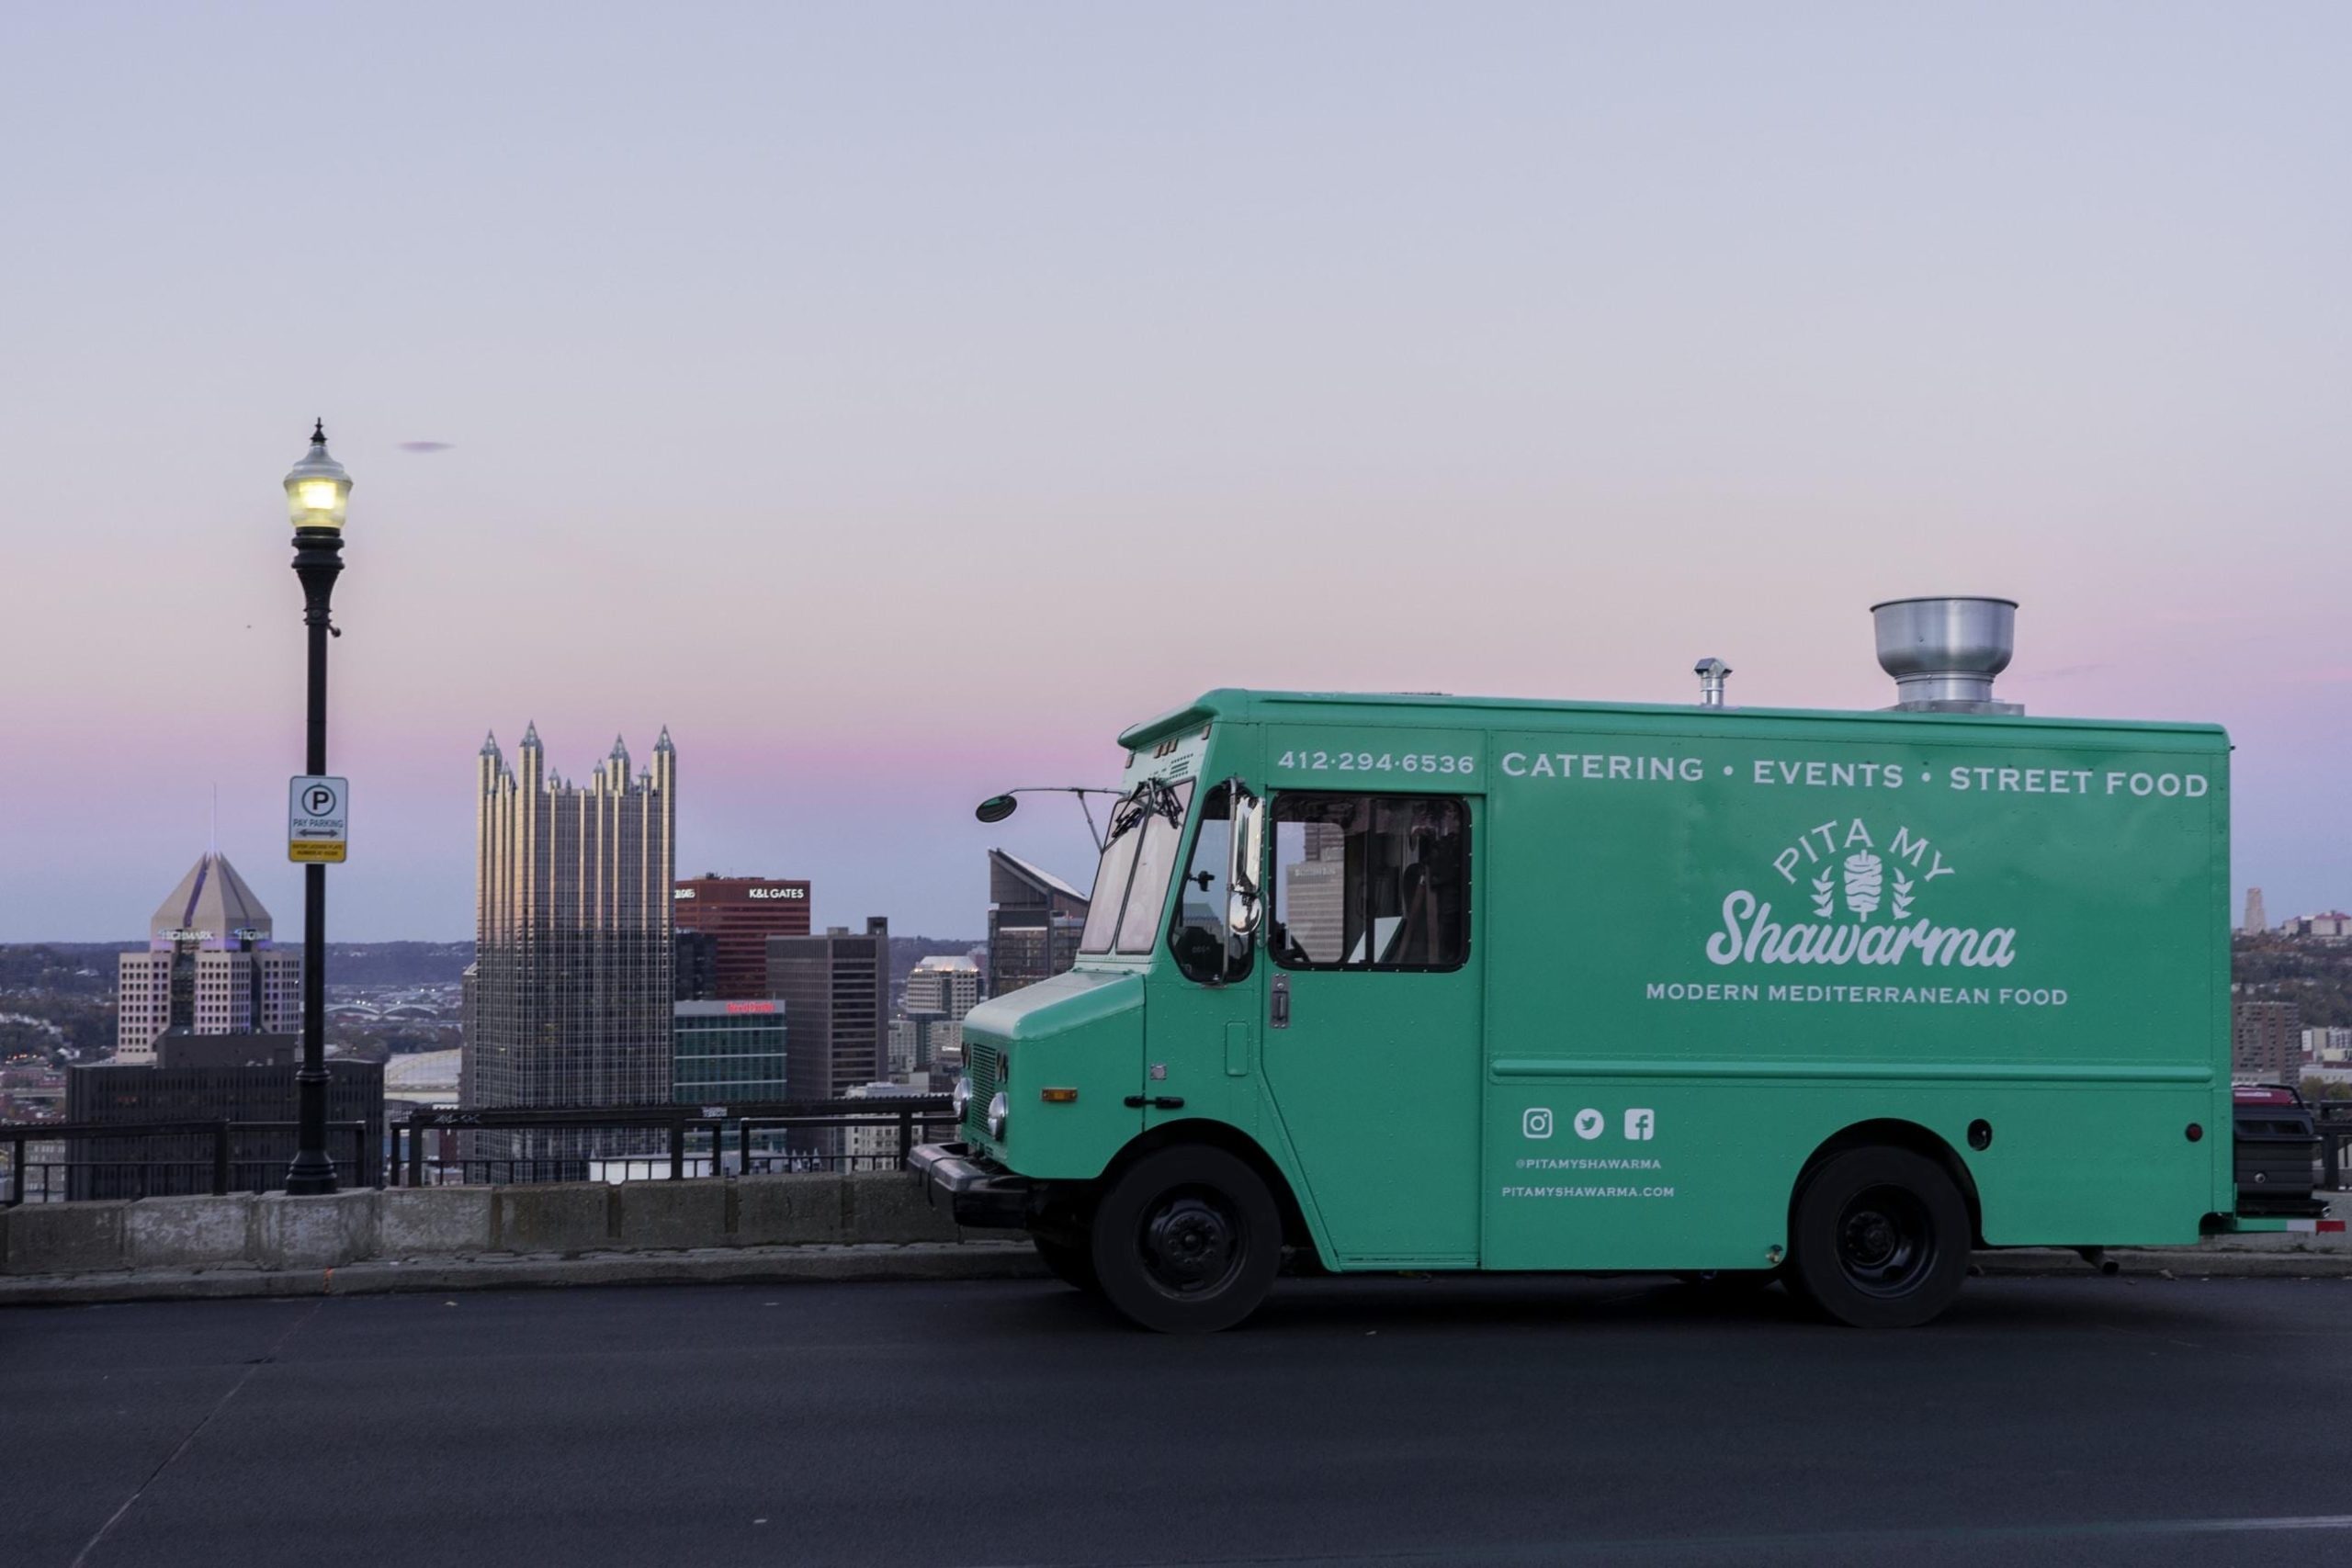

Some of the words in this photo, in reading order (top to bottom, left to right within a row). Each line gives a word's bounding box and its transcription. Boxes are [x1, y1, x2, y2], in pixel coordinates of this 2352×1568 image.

[1500, 750, 1704, 783] CATERING
[1752, 759, 1905, 790] EVENTS
[1949, 765, 2094, 795] STREET
[2105, 771, 2210, 798] FOOD
[312, 791, 329, 810] P
[293, 818, 308, 827] PAY
[309, 818, 344, 828] PARKING
[1772, 817, 1874, 885] PITA
[1888, 825, 1956, 884] MY
[749, 888, 769, 898] K&L
[770, 888, 804, 898] GATES
[1706, 890, 2017, 968] Shawarma
[1645, 983, 1759, 1001] MODERN
[1768, 985, 1990, 1005] MEDITERRANEAN
[1999, 988, 2068, 1007] FOOD
[1516, 1158, 1662, 1169] @PITAMYSHAWARMA
[1501, 1186, 1675, 1198] PITAMYSHAWARMA.COM
